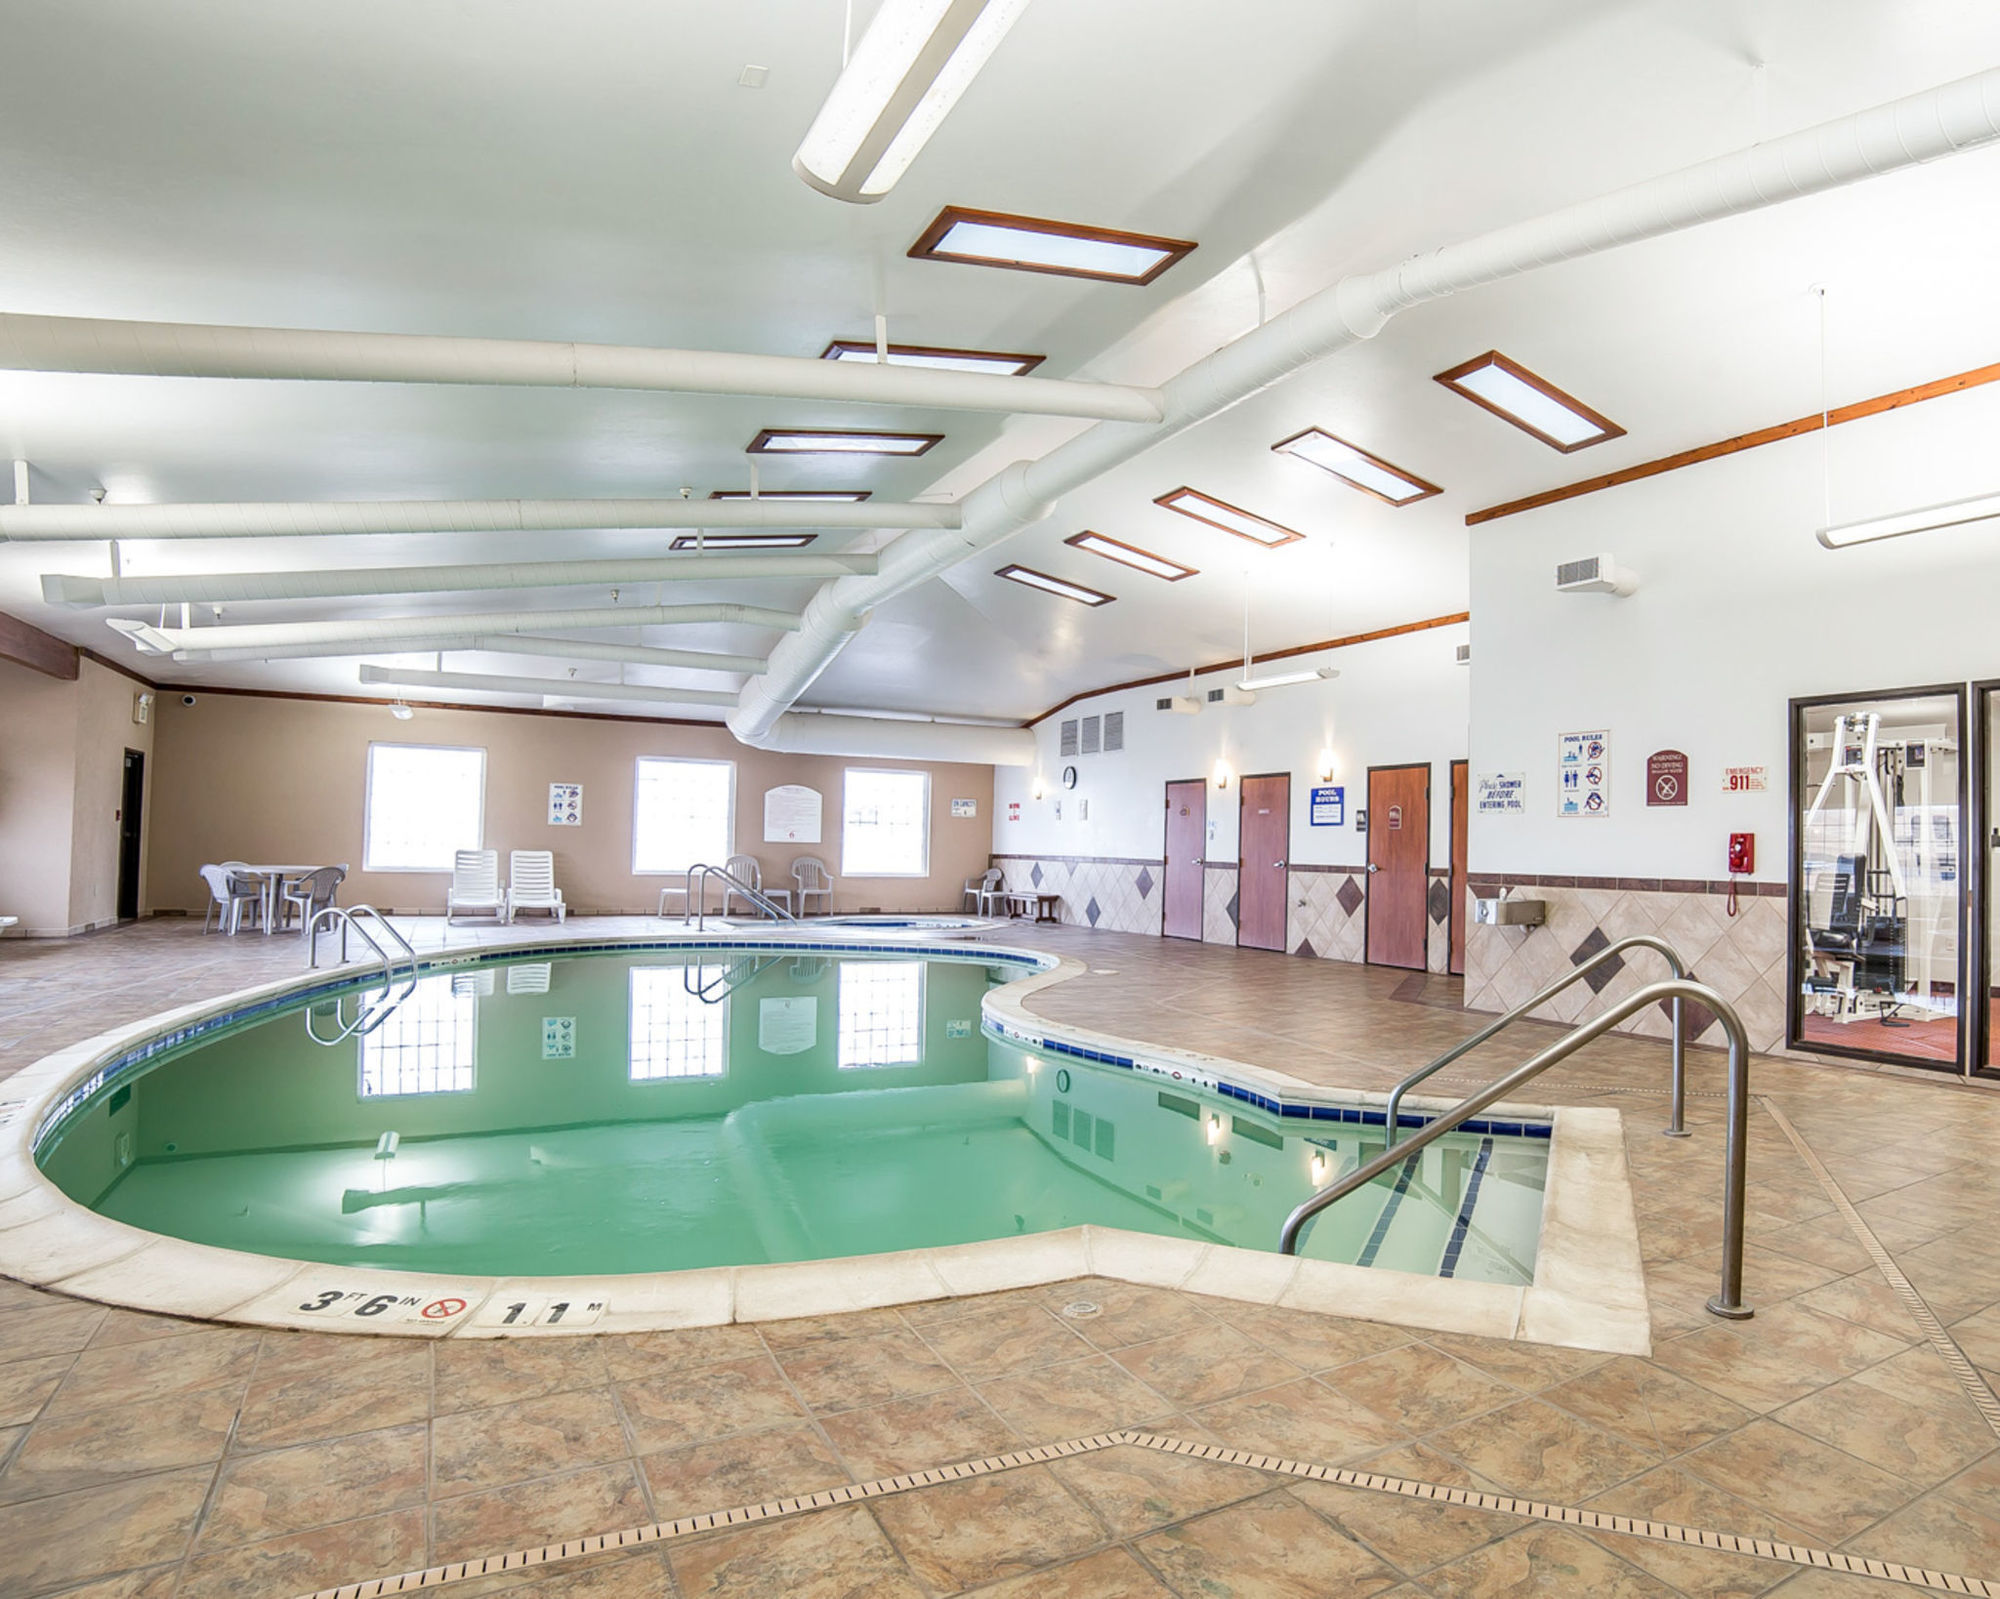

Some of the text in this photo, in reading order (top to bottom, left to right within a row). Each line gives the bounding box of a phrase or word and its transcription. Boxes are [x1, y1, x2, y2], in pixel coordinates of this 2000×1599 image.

[1725, 766, 1764, 775] EMERGENCY
[1498, 780, 1521, 789] SHOWER
[1730, 775, 1749, 790] 911
[1487, 790, 1514, 799] BEFORE
[1479, 800, 1521, 809] ENTERING POOL
[299, 1290, 421, 1316] 3 FT 6 IN
